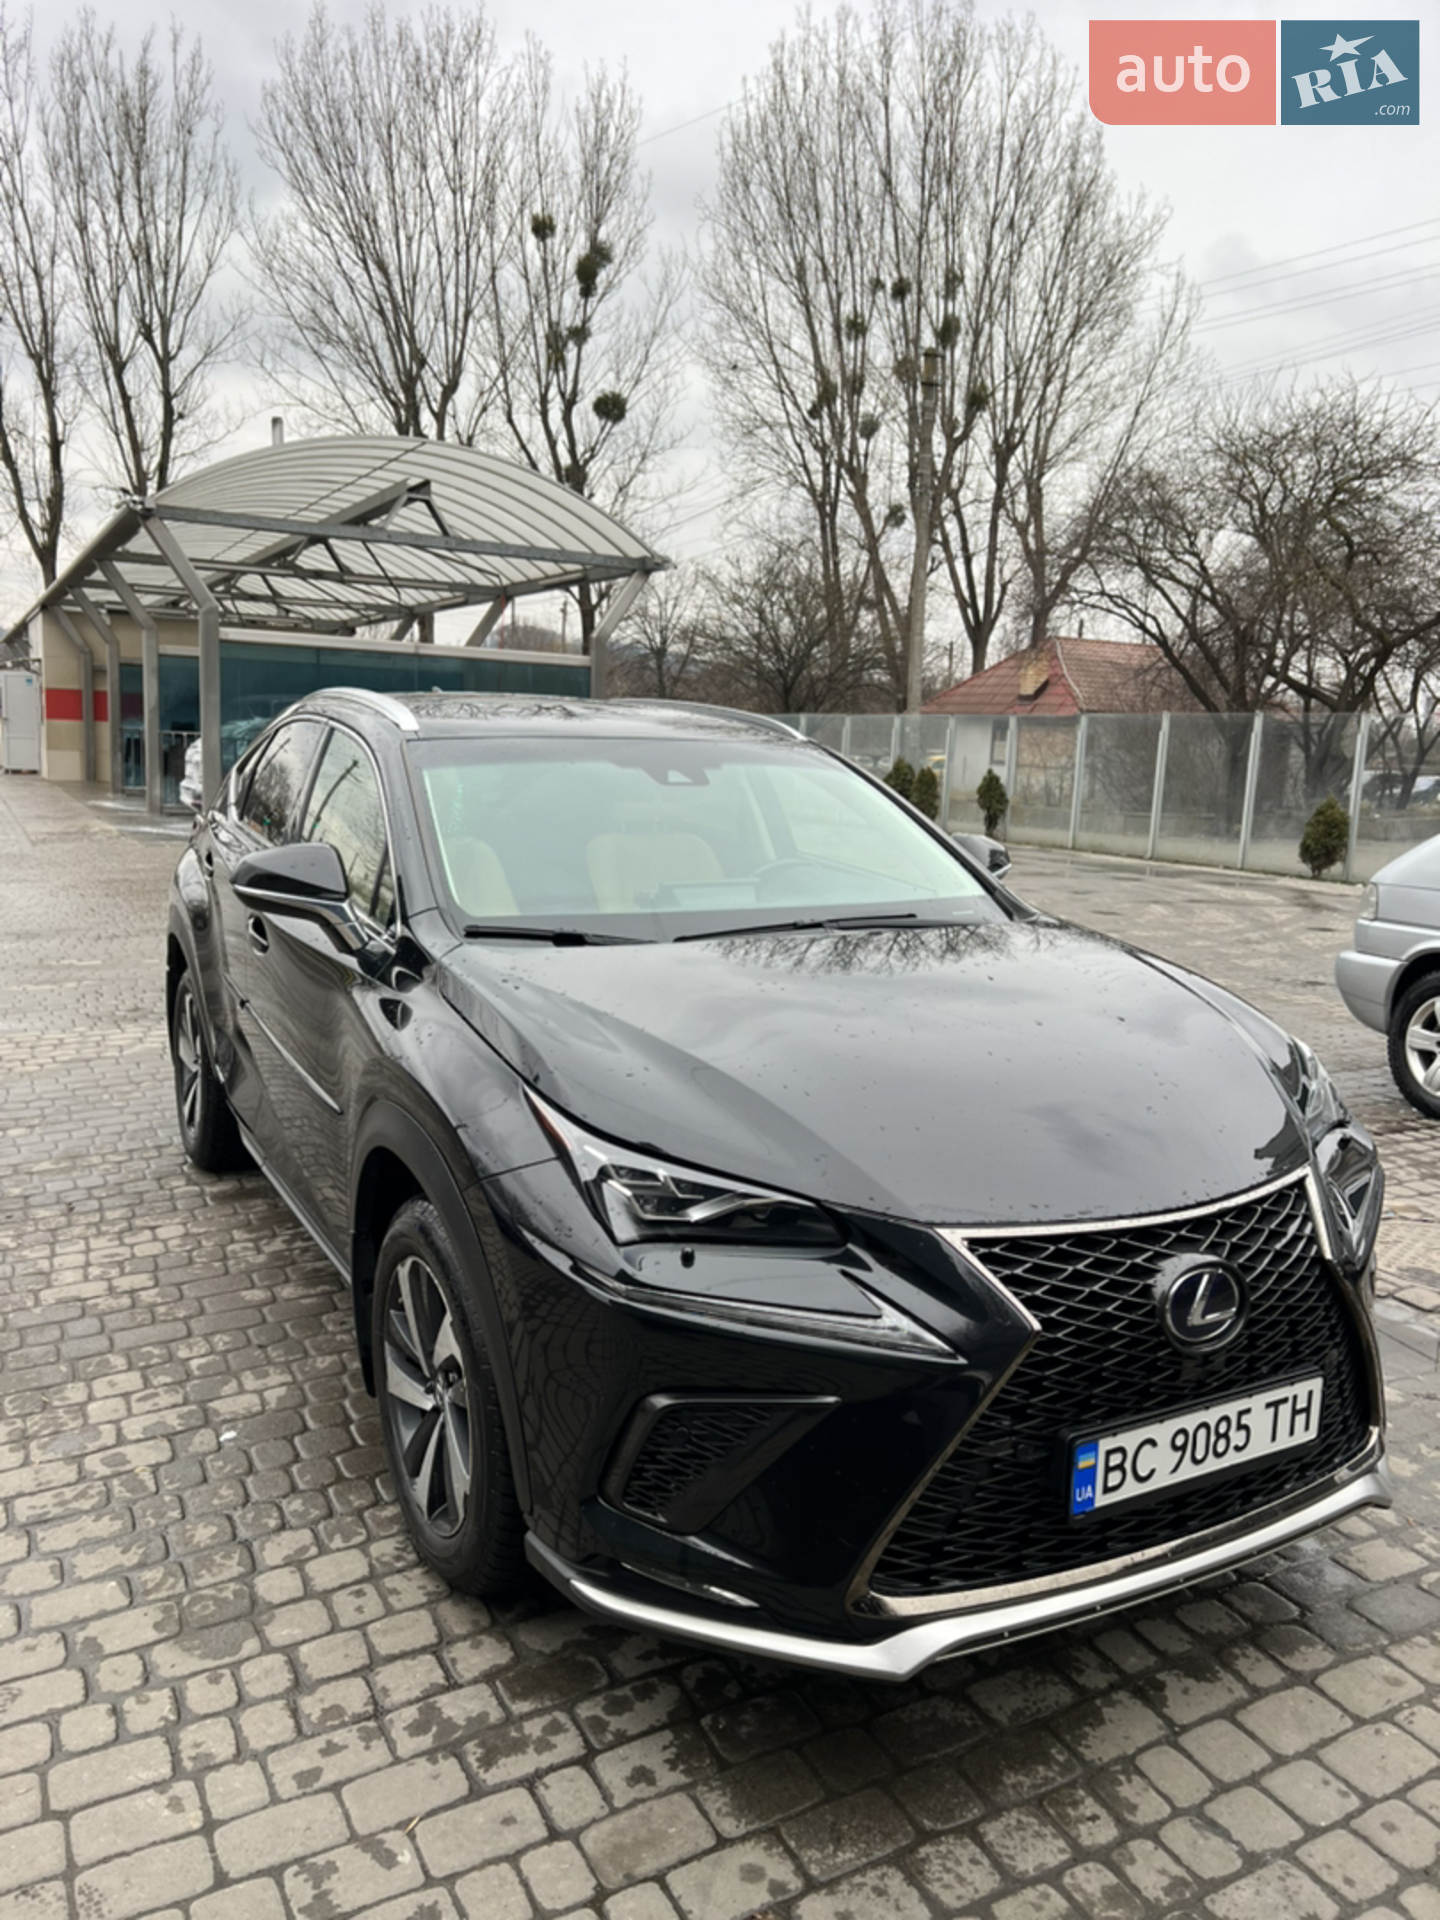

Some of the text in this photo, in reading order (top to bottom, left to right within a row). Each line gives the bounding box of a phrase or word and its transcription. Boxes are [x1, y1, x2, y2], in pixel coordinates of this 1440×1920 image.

[1101, 1389, 1314, 1495] BC 9085 TH
[1075, 1485, 1094, 1503] UA
